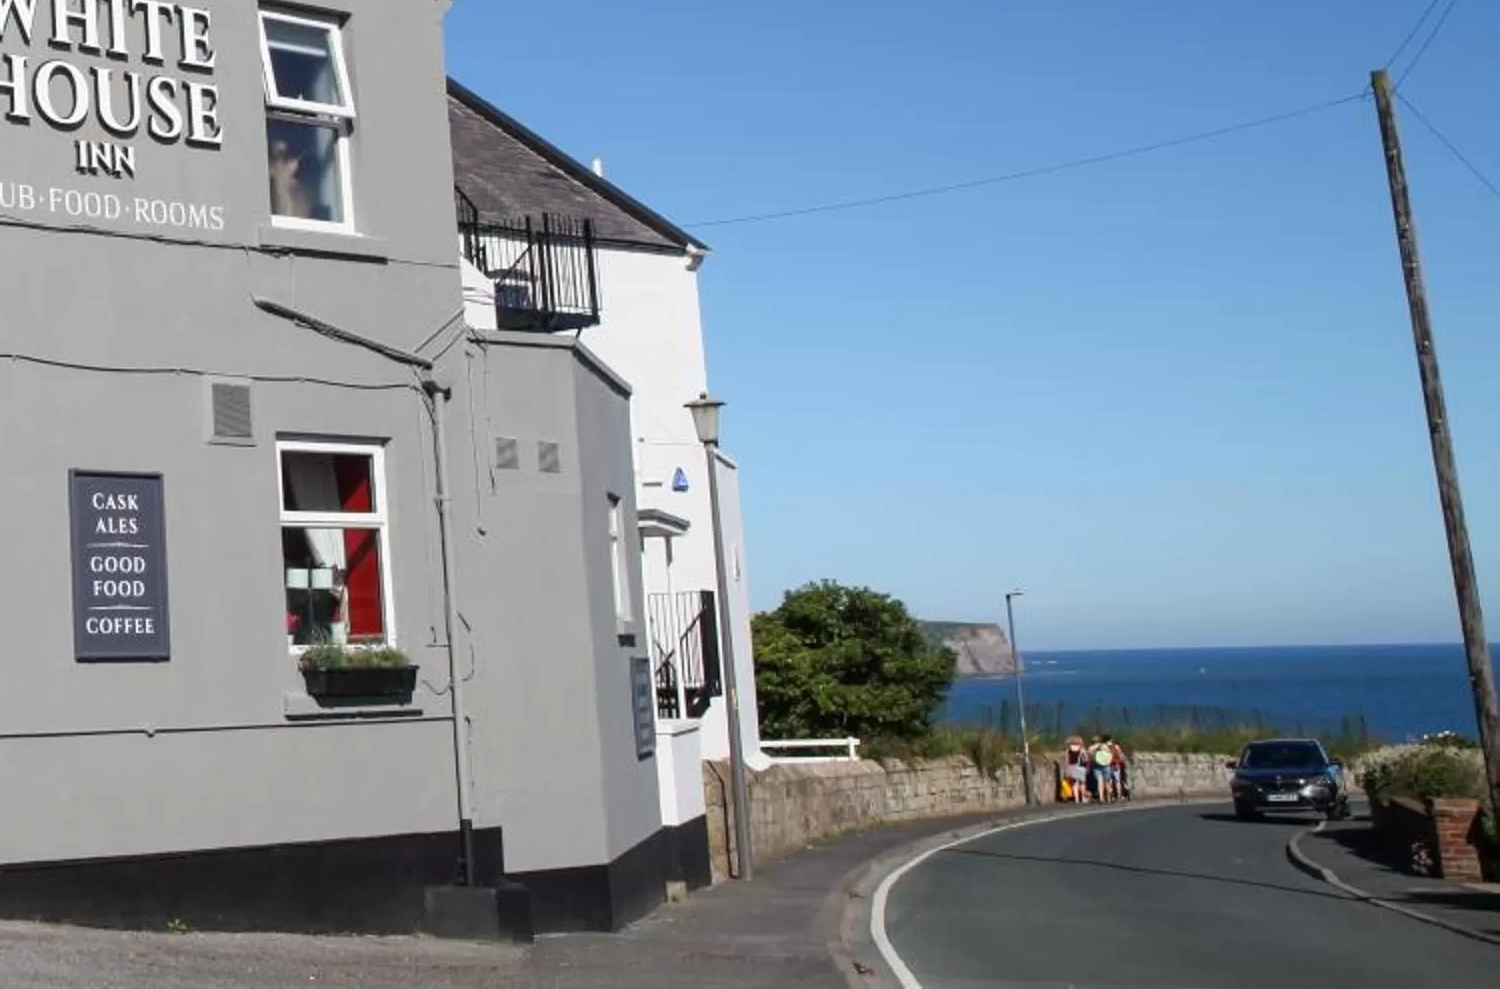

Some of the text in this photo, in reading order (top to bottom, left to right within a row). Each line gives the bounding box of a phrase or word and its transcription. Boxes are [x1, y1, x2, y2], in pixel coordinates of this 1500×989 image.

[76, 140, 136, 176] INN
[91, 492, 140, 511] CASK
[95, 516, 140, 535] ALES
[90, 556, 146, 574] GOOD
[92, 579, 146, 597] FOOD
[85, 617, 156, 635] COFFEE
